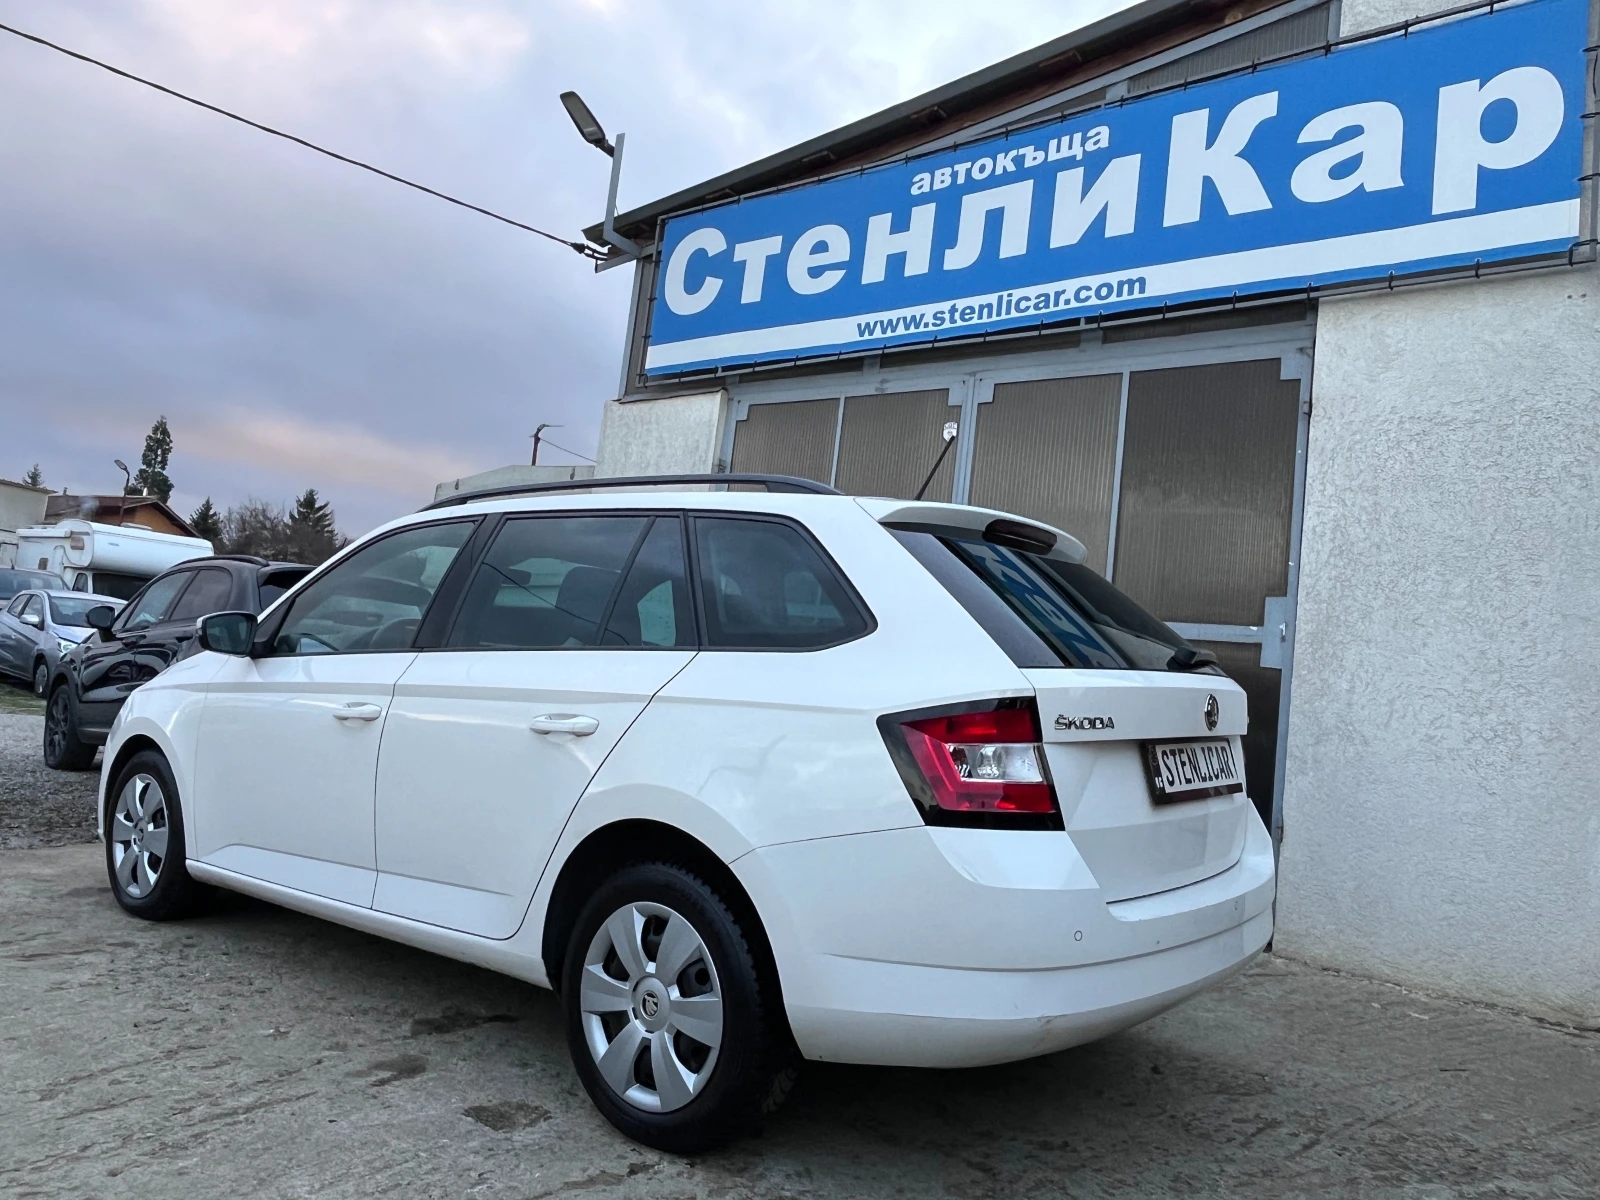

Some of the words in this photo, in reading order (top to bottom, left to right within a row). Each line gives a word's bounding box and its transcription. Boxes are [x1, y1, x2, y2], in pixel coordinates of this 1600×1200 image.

[910, 125, 1110, 195] автокъща
[856, 275, 1147, 338] www.stenlicar.com
[1054, 714, 1115, 730] ŠKODA
[1161, 745, 1235, 787] STENLICAR
